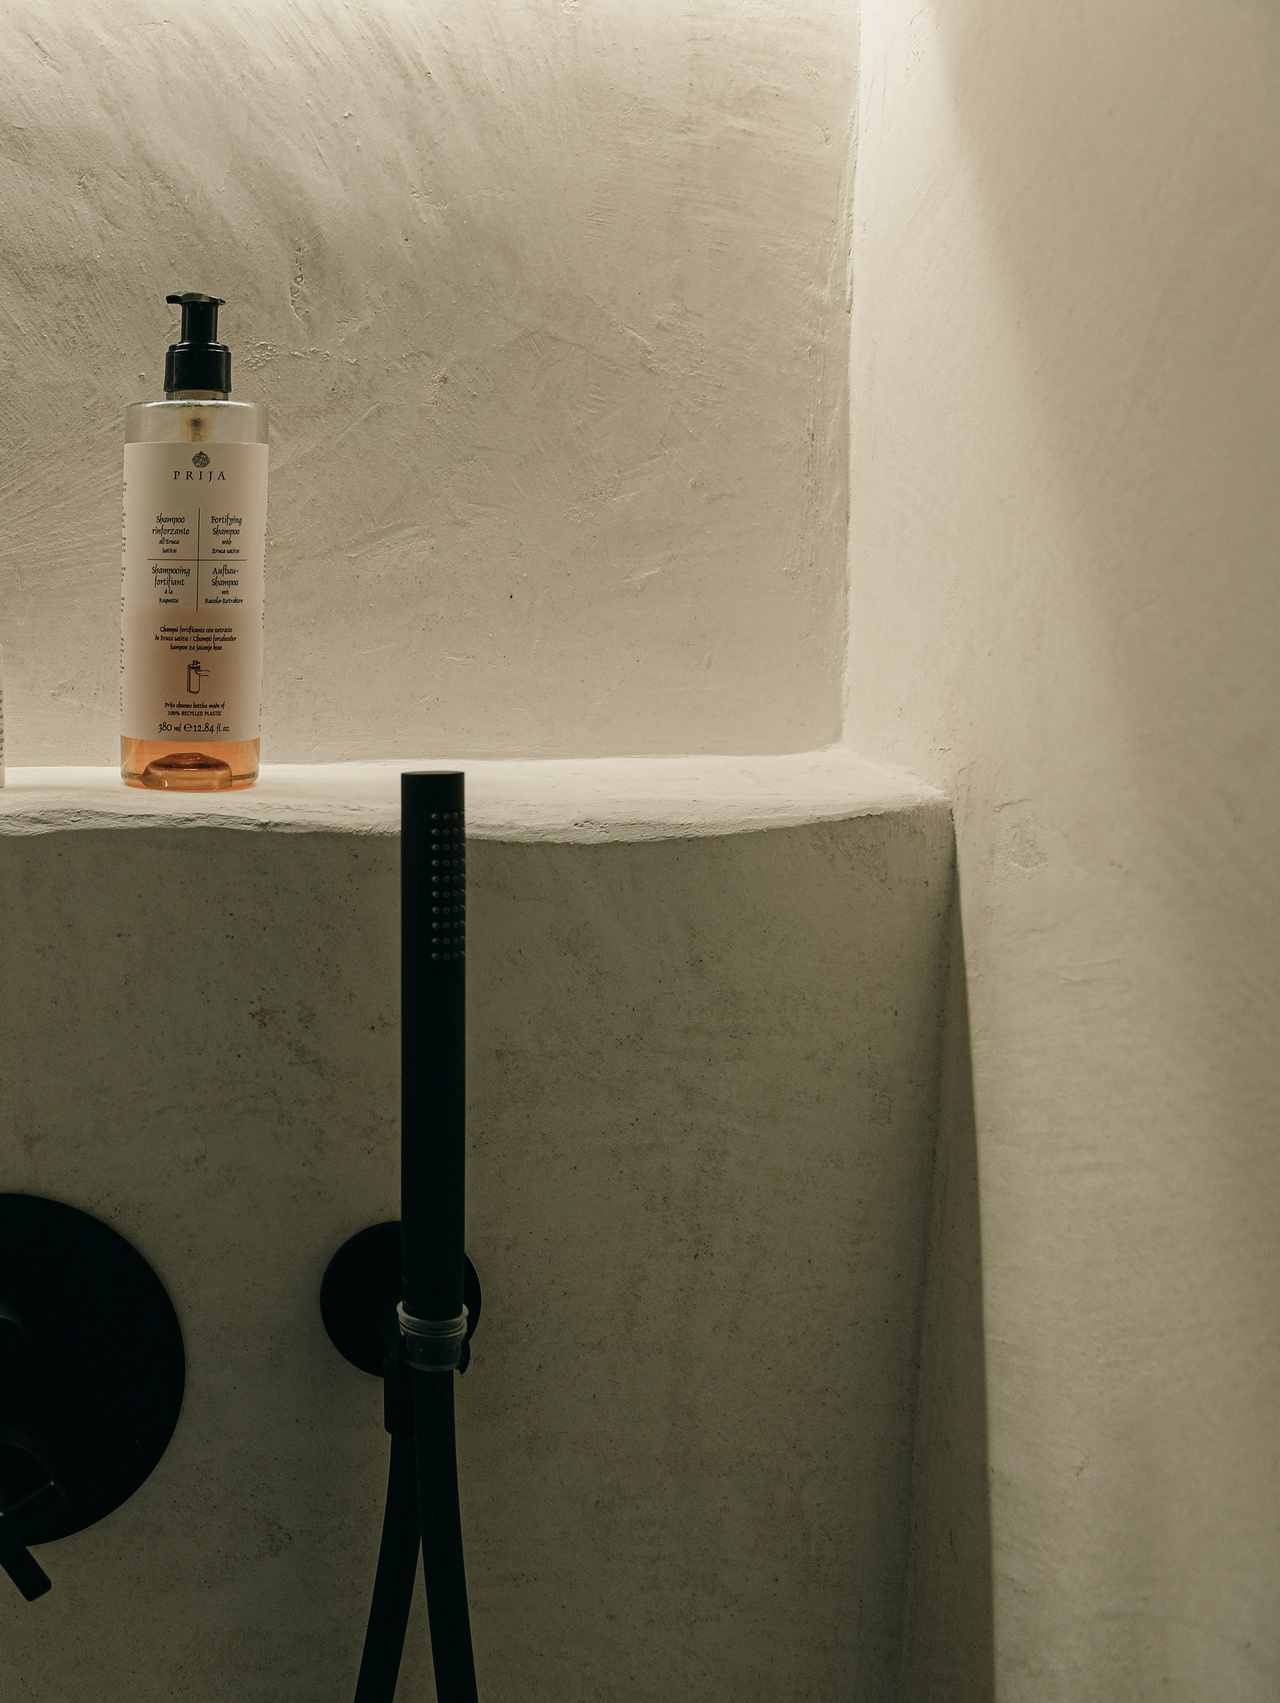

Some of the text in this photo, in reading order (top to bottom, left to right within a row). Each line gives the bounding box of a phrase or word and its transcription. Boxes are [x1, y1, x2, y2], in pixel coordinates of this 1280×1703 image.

[174, 471, 226, 482] PRIJA
[156, 512, 186, 525] Shampoo
[210, 513, 242, 526] Fortifying
[152, 524, 190, 536] rinforzante
[212, 524, 240, 536] Shampoo
[152, 564, 190, 576] Shampooing
[154, 576, 184, 588] fortifiant
[211, 576, 238, 588] Shampoo
[158, 722, 172, 733] 380
[174, 723, 181, 731] ml
